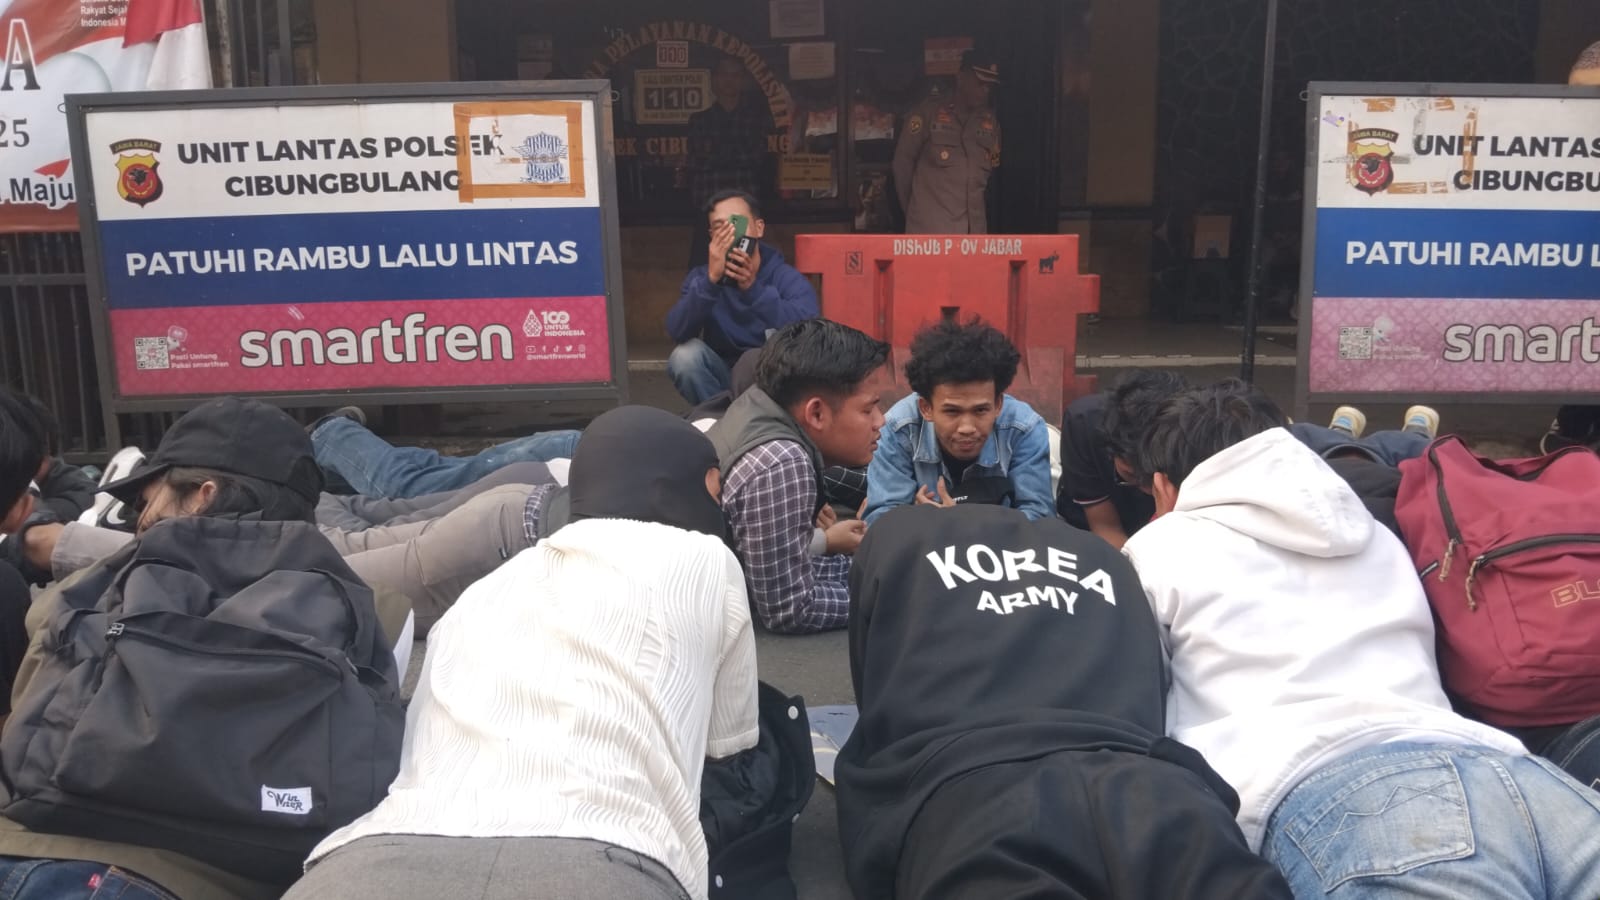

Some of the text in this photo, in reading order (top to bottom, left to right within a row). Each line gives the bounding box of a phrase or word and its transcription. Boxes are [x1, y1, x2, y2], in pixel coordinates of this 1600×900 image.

[80, 6, 106, 16] Rakyat
[81, 18, 119, 27] Indonesia
[648, 89, 699, 108] 110
[177, 141, 250, 164] UNIT
[256, 137, 378, 162] LANTAS
[1413, 135, 1484, 157] UNIT
[9, 177, 74, 207] Maju
[225, 170, 463, 197] CIBUNGBULANG
[1453, 170, 1600, 192] CIBUNGBU
[126, 240, 578, 276] PATUHI RAMBU LALU LINTAS
[982, 238, 1023, 256] JABAR
[1346, 241, 1461, 265] PATUHI
[1469, 242, 1584, 267] RAMBU
[239, 312, 514, 368] smartfren
[544, 329, 586, 337] INDONESIA
[1442, 316, 1600, 364] smart
[925, 543, 1117, 606] KOREA
[976, 585, 1078, 615] ARMY
